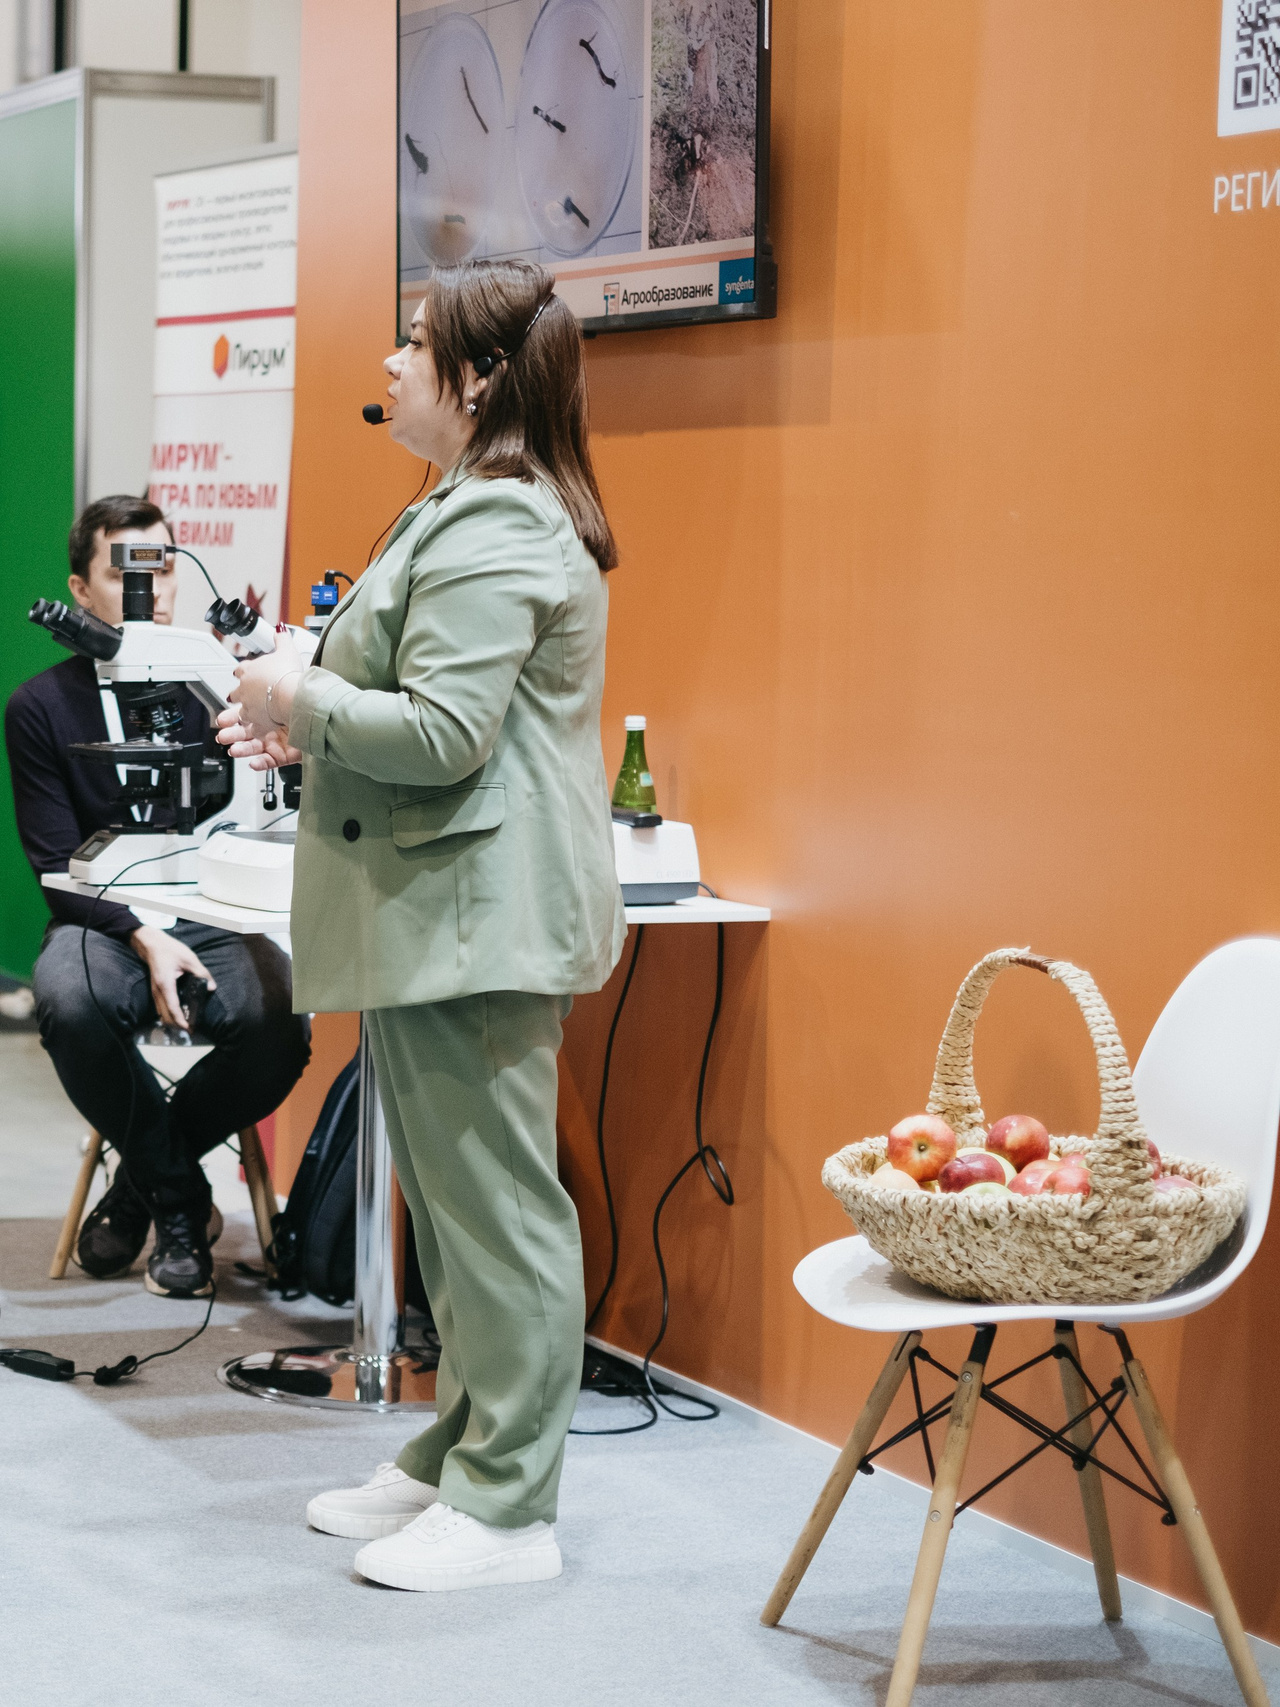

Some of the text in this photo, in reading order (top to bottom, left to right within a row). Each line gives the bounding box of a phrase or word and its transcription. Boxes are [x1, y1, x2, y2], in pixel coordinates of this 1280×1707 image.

[1213, 169, 1280, 214] РЕГИ
[621, 283, 714, 308] Агрообразование
[725, 277, 755, 295] syngenta
[196, 483, 217, 509] ПО
[218, 483, 278, 509] НОВЫМ
